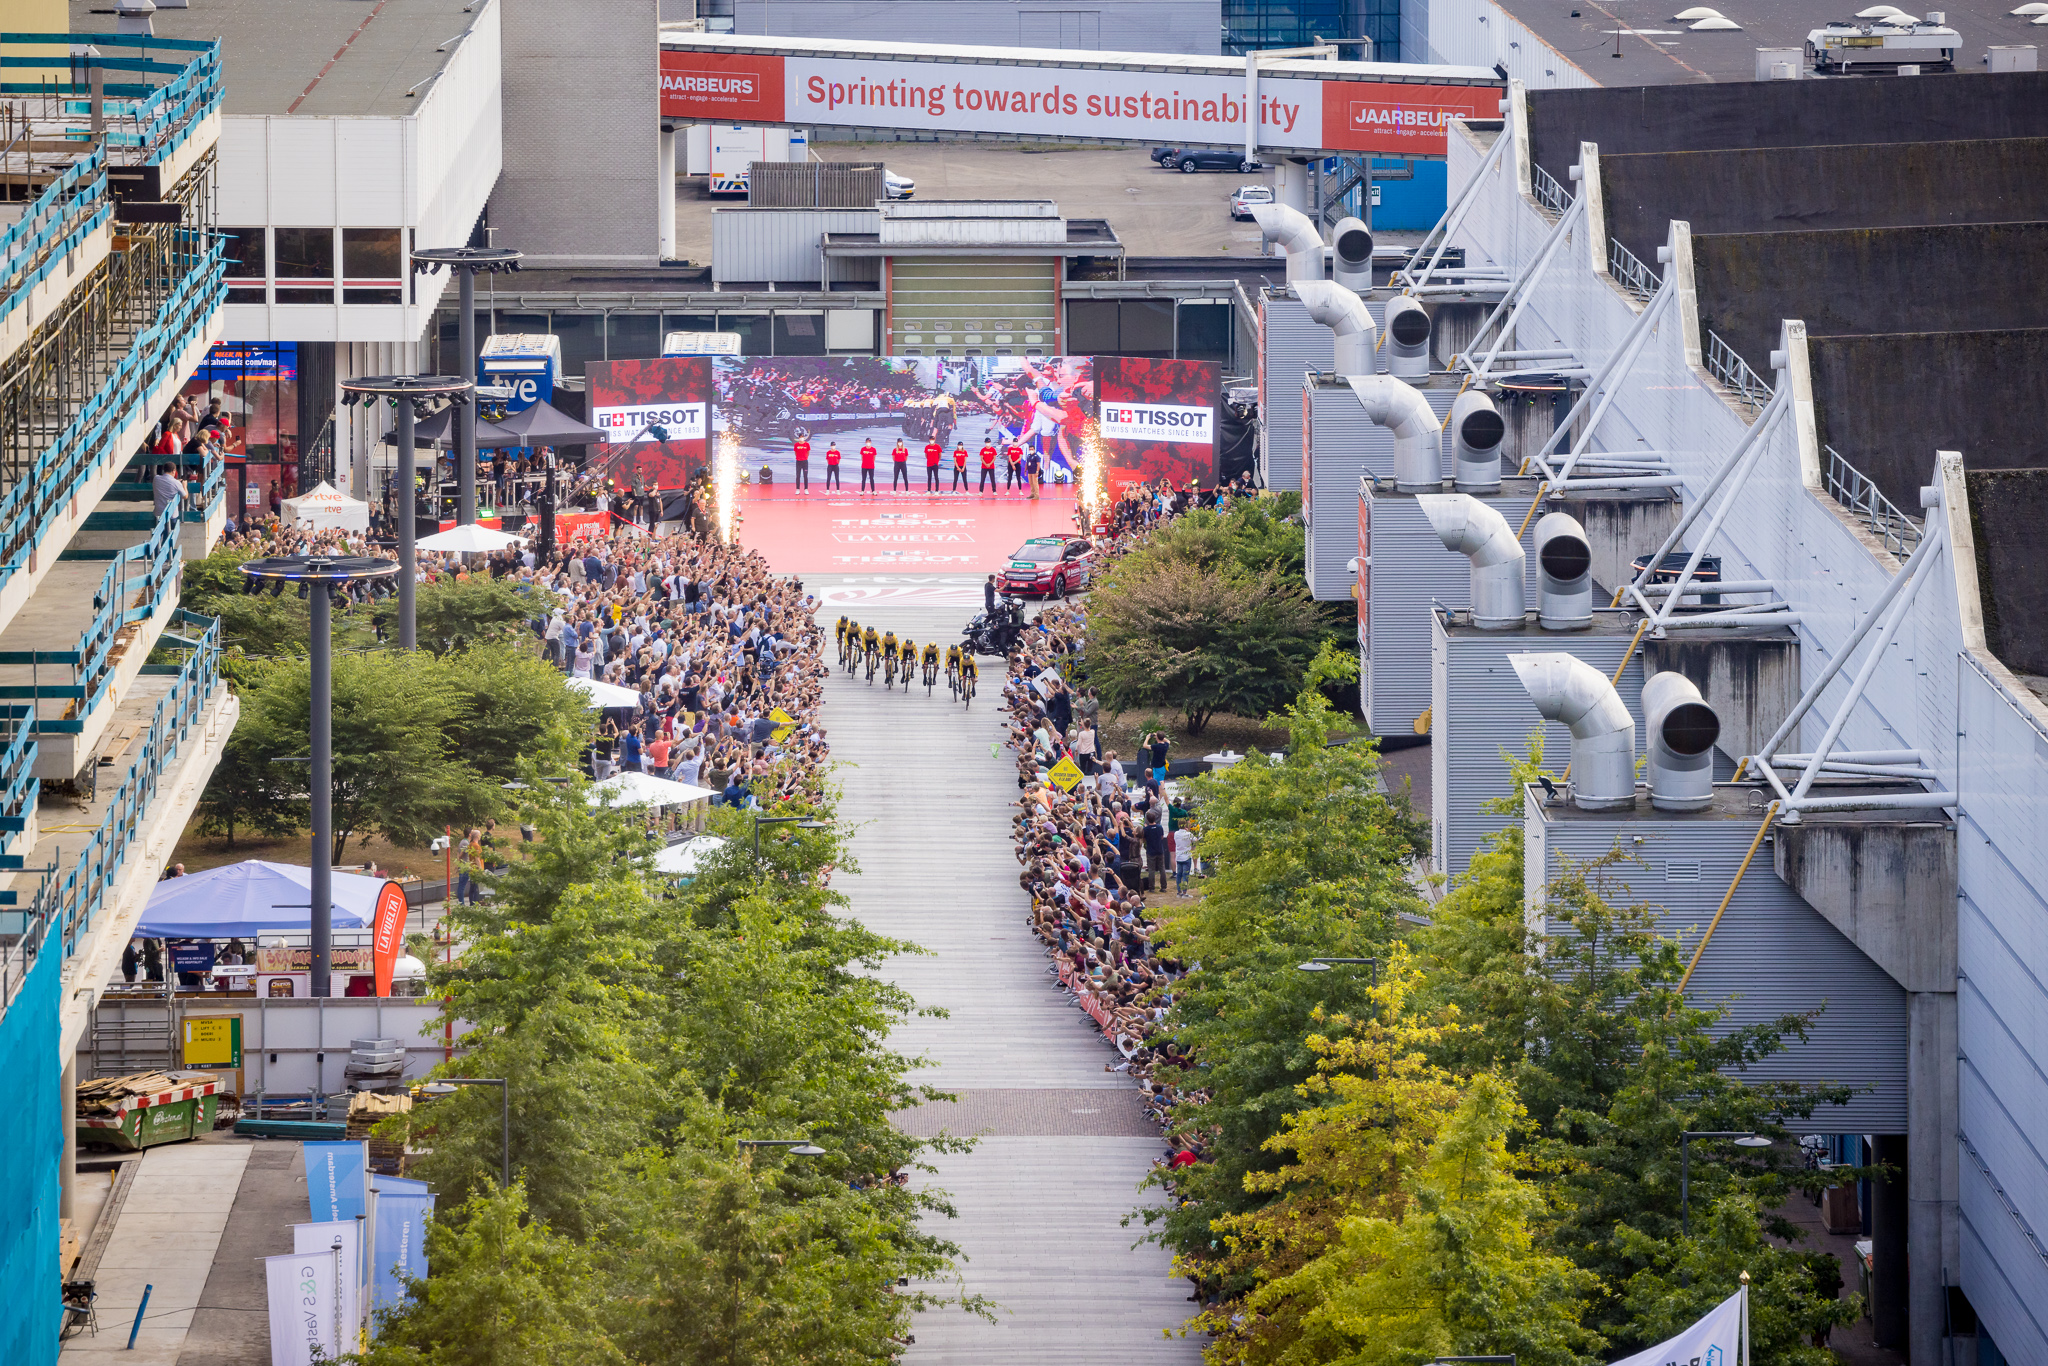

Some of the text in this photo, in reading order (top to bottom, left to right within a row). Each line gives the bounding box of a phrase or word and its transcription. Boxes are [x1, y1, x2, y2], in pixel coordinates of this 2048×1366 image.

[660, 75, 753, 94] AARBEURS
[807, 75, 1300, 133] Sprinting towards sustainabiity
[626, 409, 699, 426] TISSOT
[1135, 410, 1207, 427] TISSOT
[1132, 427, 1165, 435] WATCHES
[314, 493, 342, 501] rtve
[380, 900, 399, 949] LA VUELTA
[266, 950, 311, 965] SPAANS
[398, 1221, 411, 1266] Eesteren
